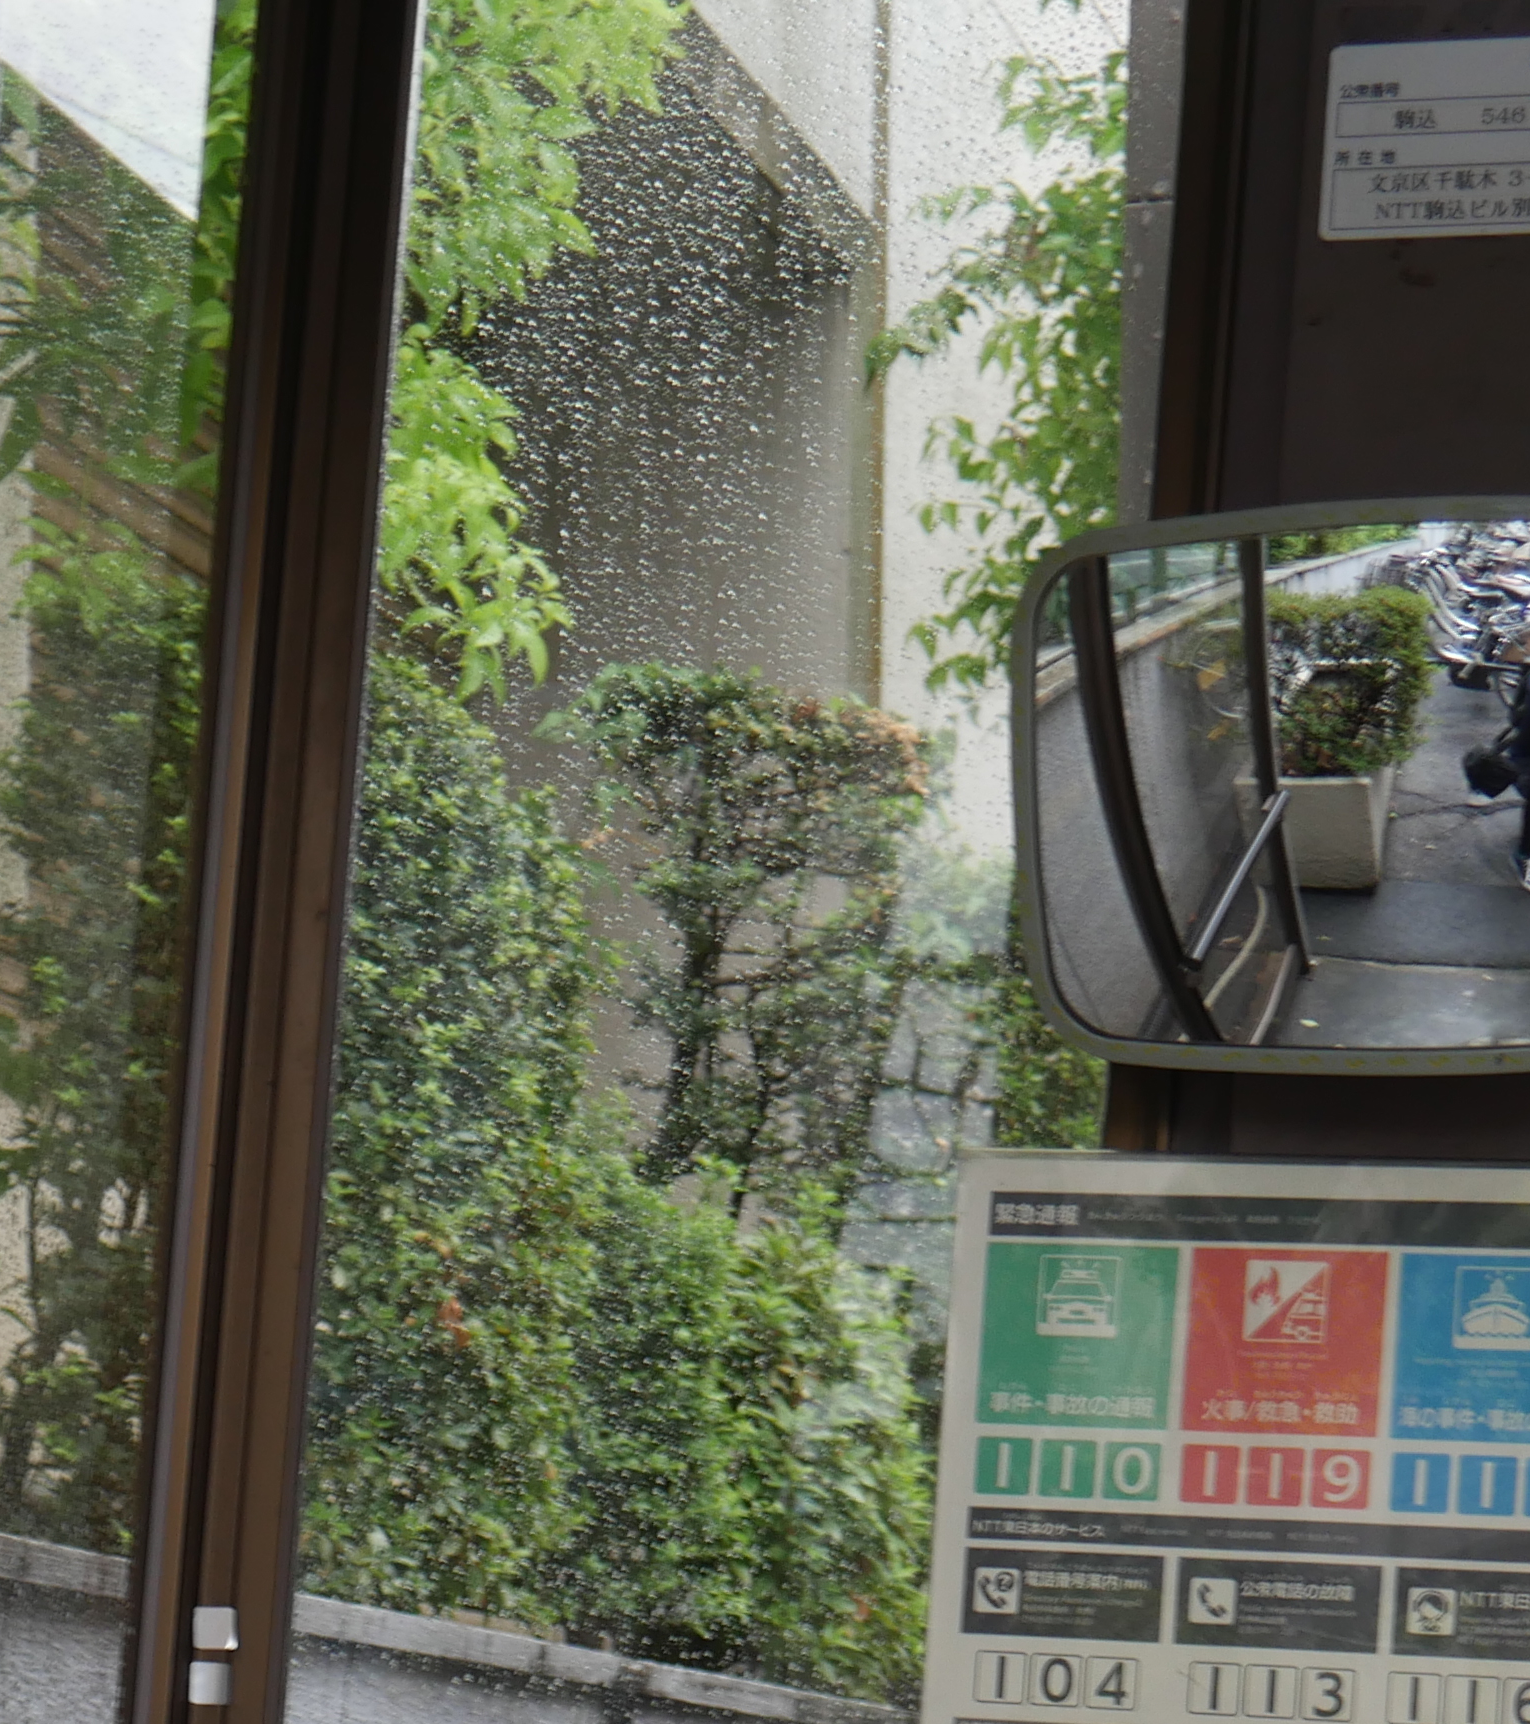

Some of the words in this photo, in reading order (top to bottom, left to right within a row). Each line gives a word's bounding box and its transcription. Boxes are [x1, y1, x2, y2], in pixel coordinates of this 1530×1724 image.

[1481, 106, 1526, 125] 546
[990, 1391, 1157, 1419] 事件・事故の通報
[996, 1442, 1151, 1495] 110
[1202, 1450, 1362, 1502] 119
[996, 1655, 1128, 1706] 104
[1207, 1665, 1345, 1718] 113
